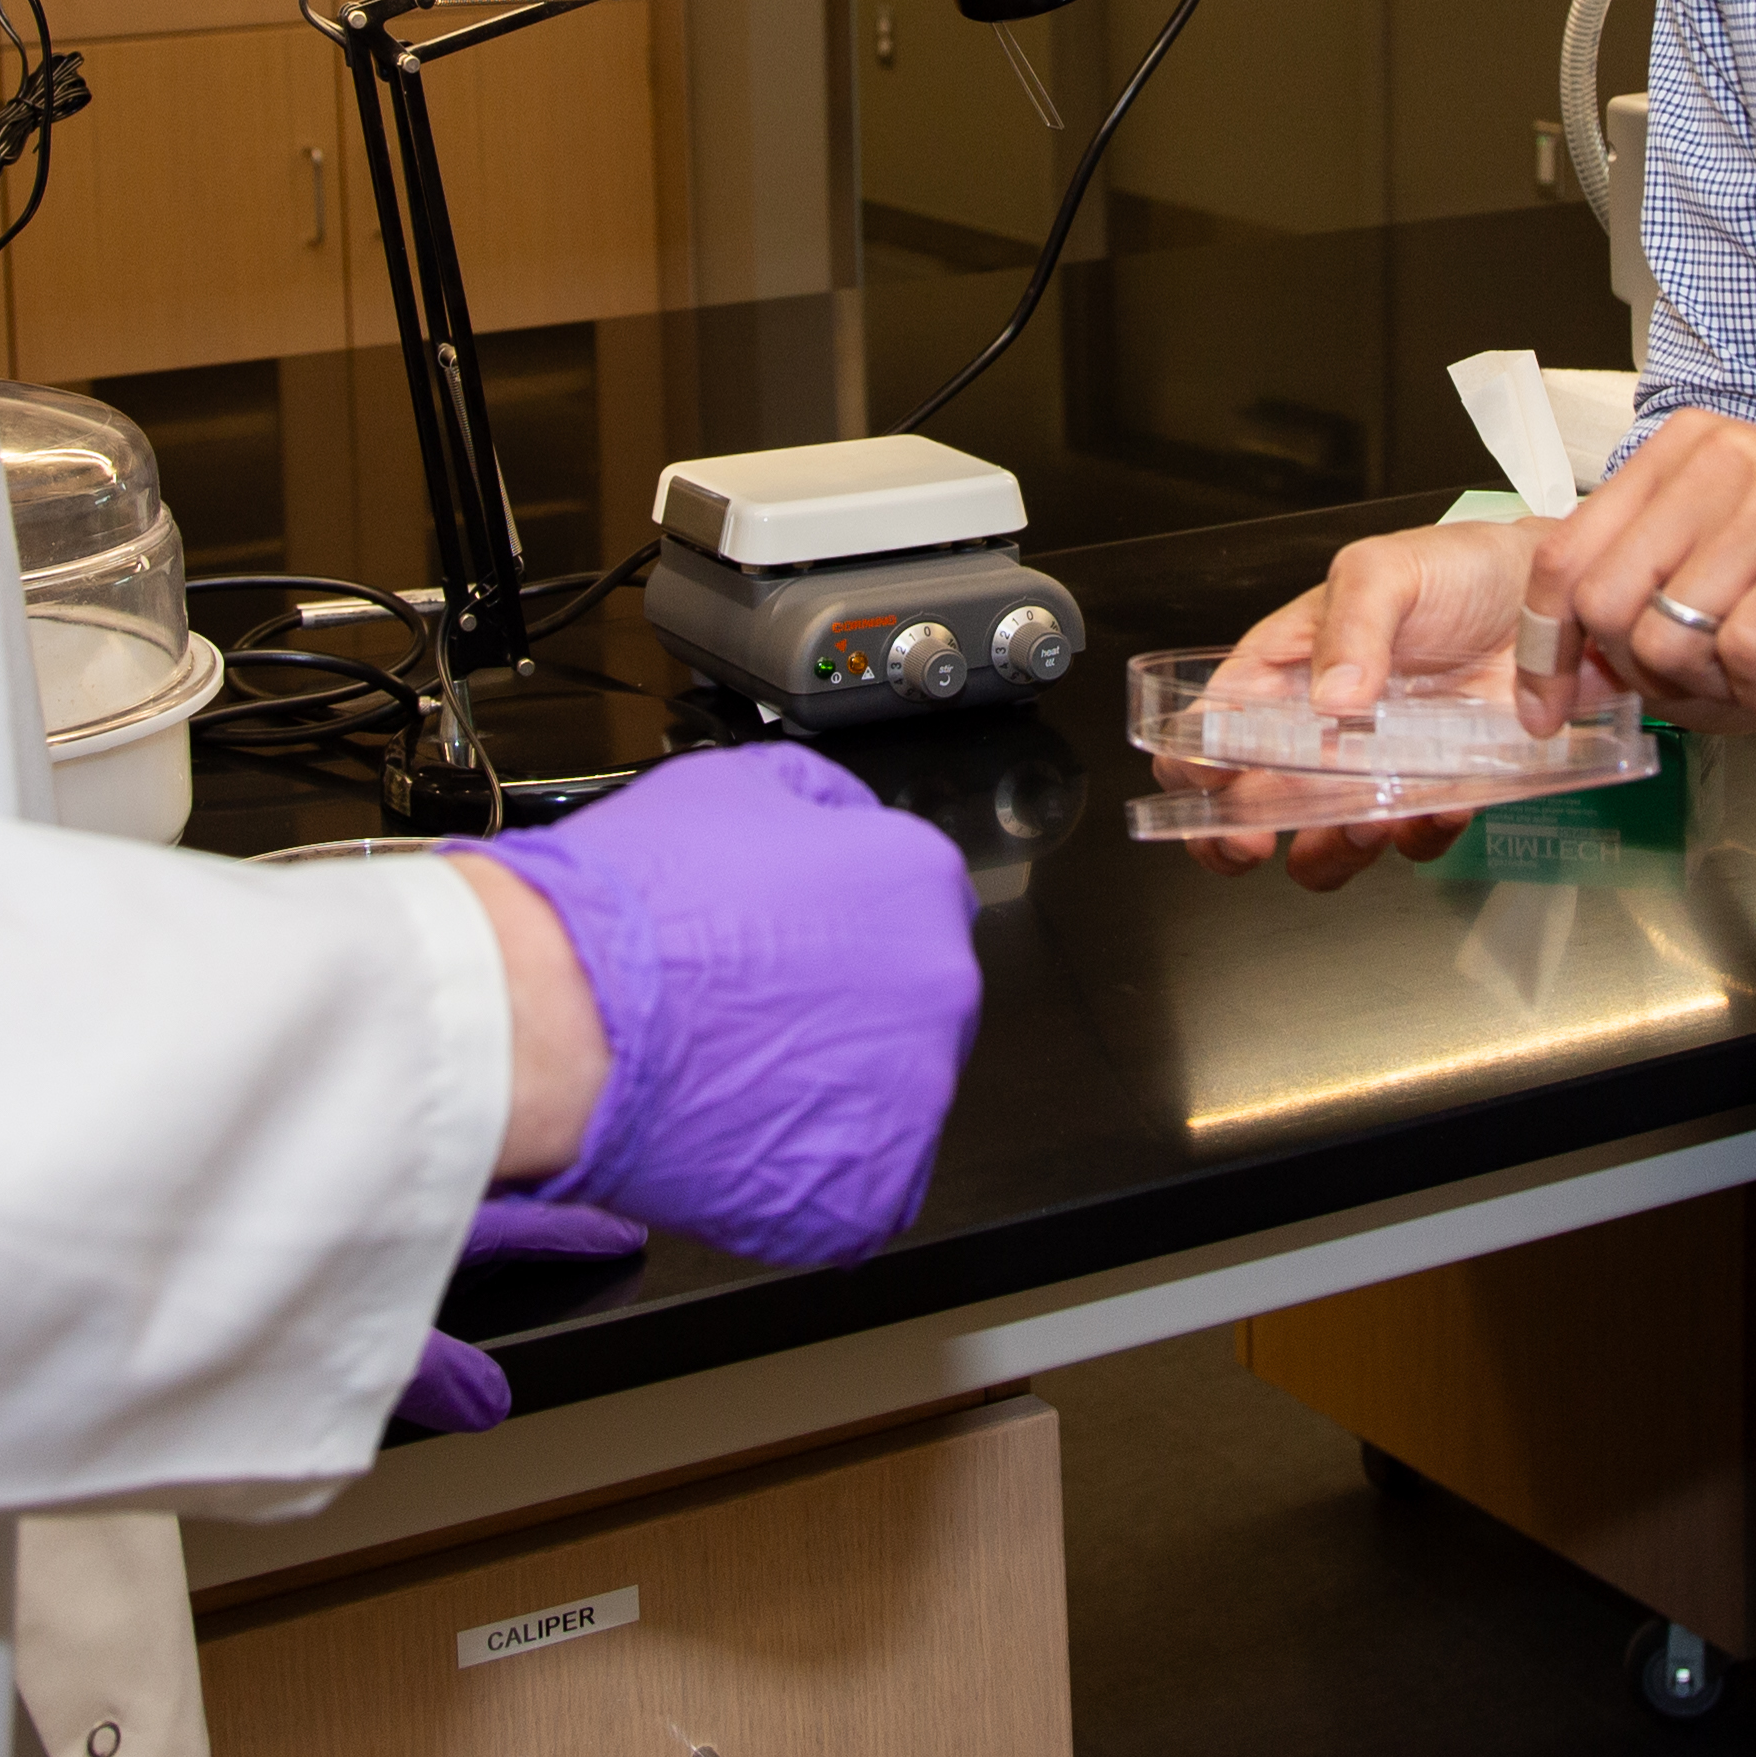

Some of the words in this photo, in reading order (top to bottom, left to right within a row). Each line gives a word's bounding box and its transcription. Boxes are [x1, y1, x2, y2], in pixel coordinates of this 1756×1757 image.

[1026, 610, 1034, 621] 0
[832, 614, 897, 634] CORNING
[1012, 617, 1020, 626] 1
[908, 632, 916, 642] 1
[923, 626, 932, 638] 0
[999, 630, 1011, 640] 2
[896, 645, 907, 656] 2
[995, 647, 1007, 655] 3
[1040, 646, 1060, 658] heat
[891, 662, 902, 670] 3
[938, 664, 954, 674] stir
[487, 1606, 596, 1652] CALIPER
